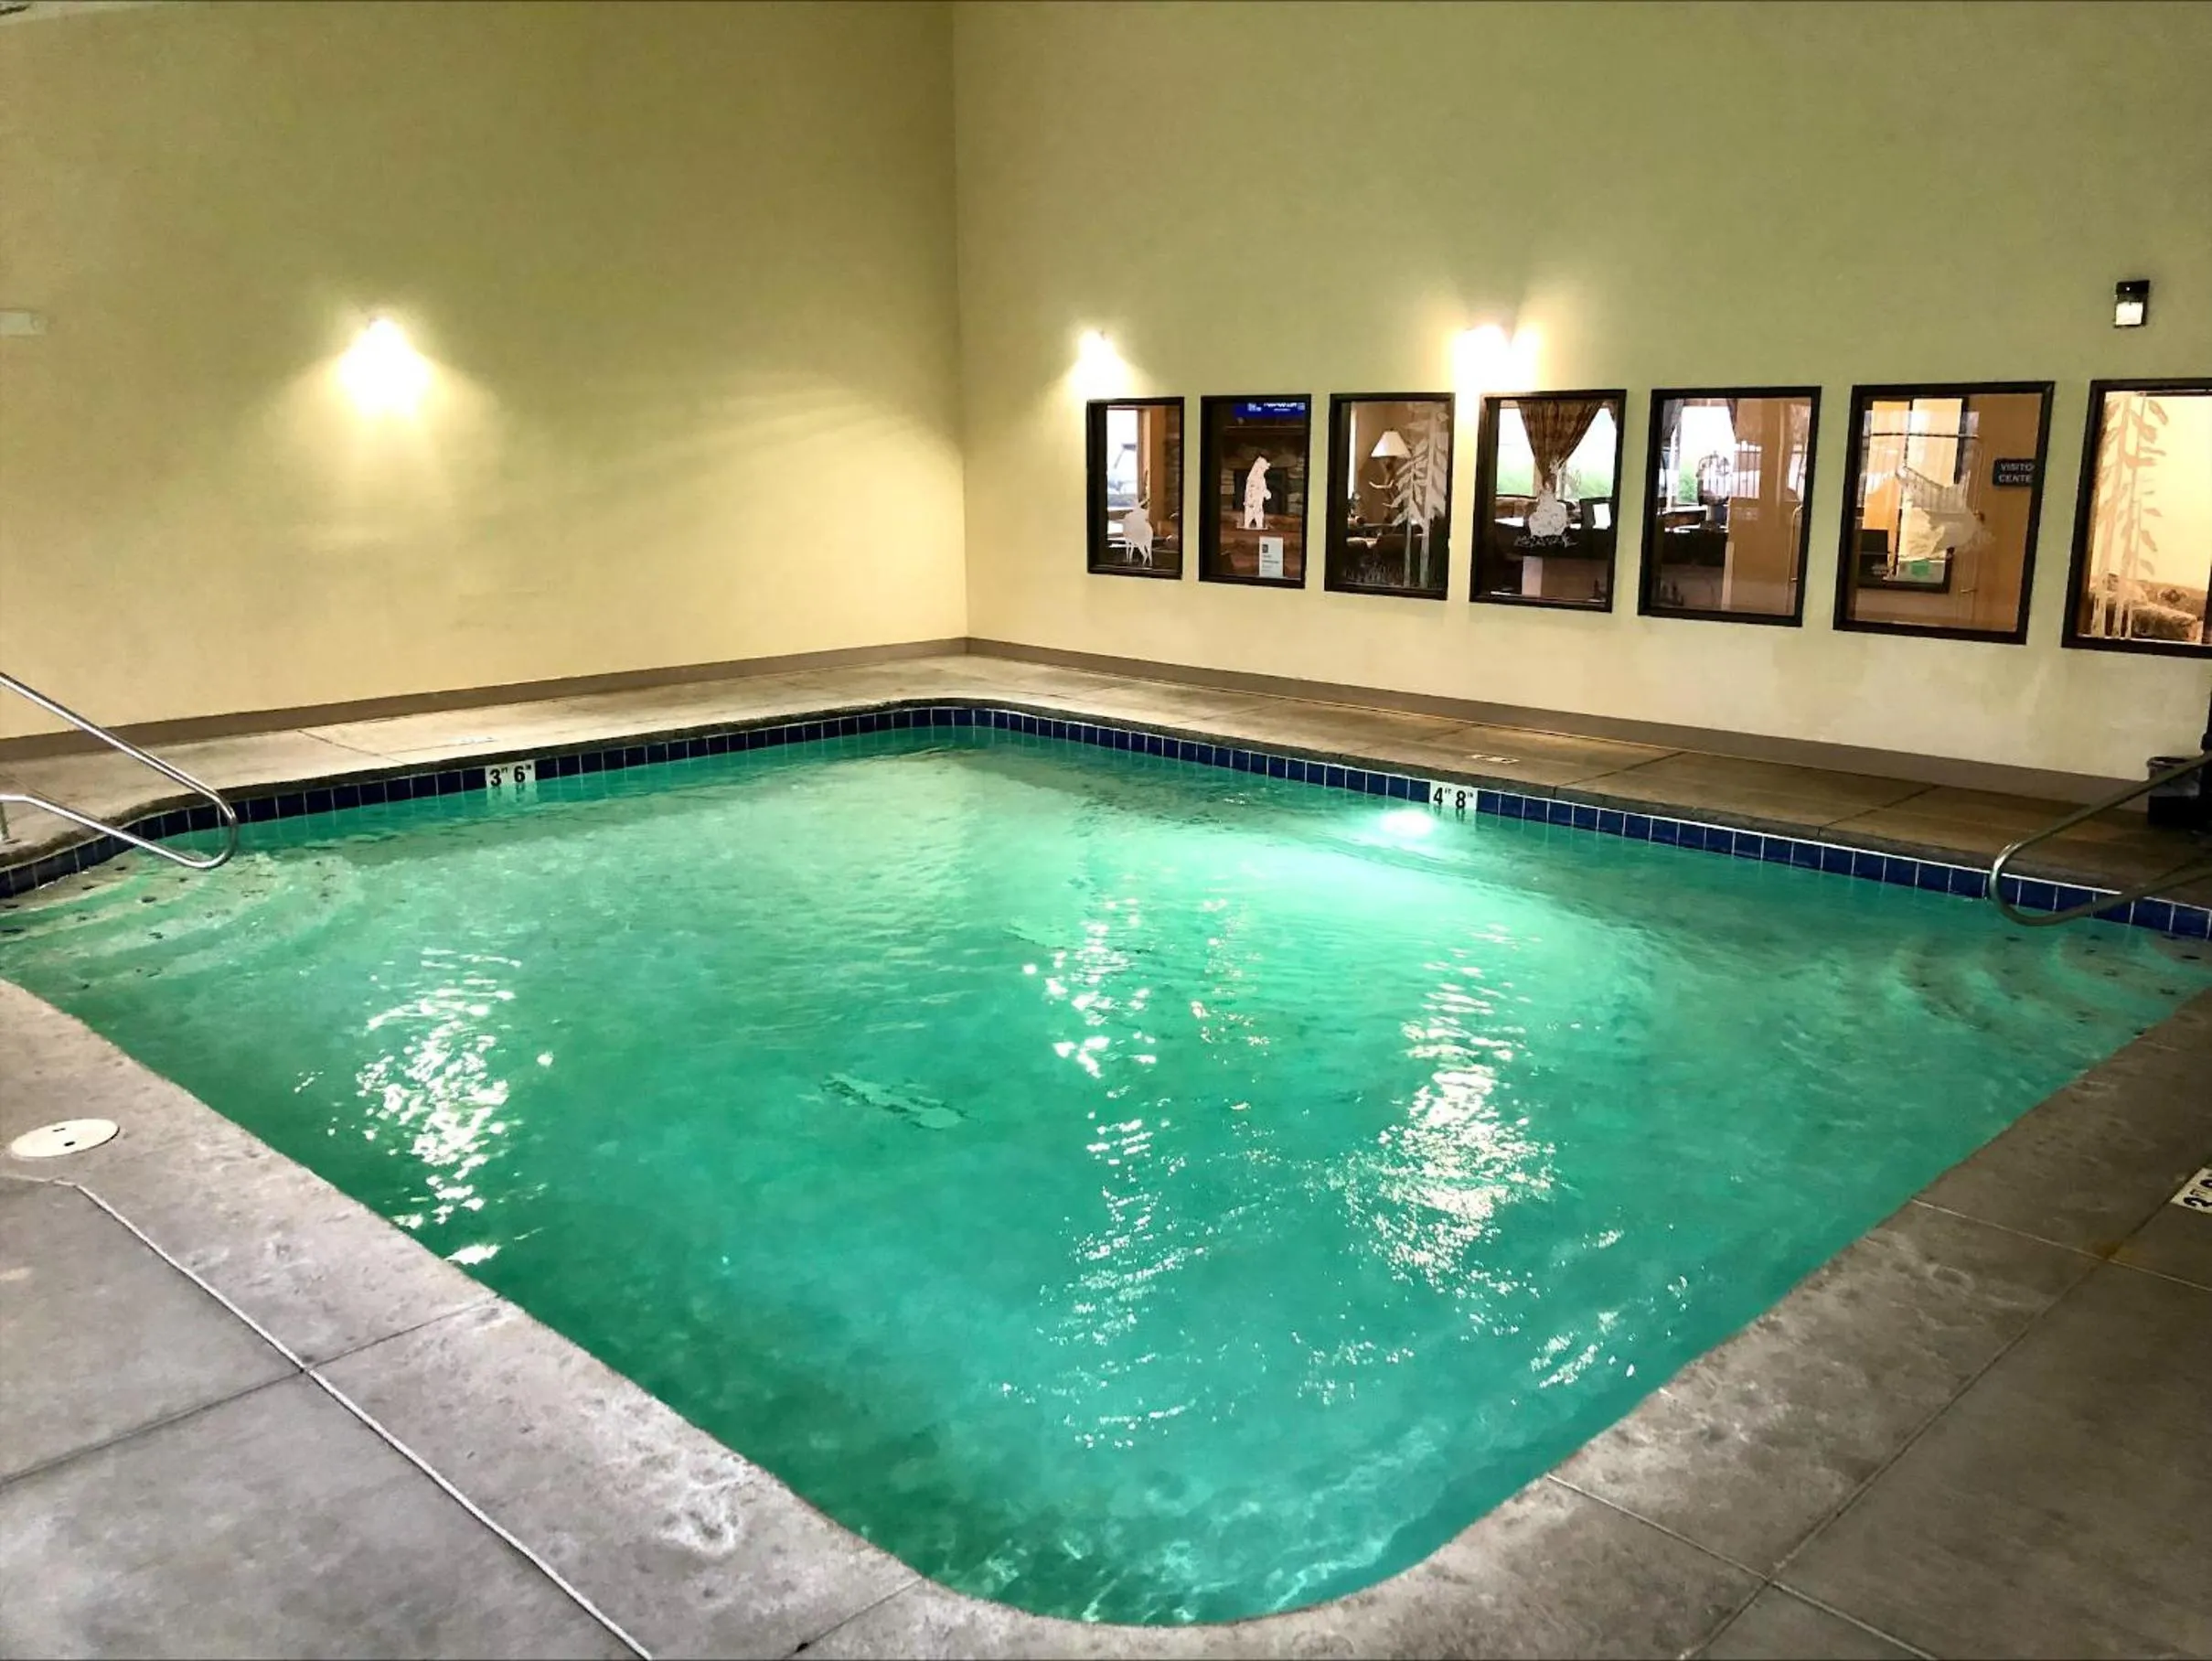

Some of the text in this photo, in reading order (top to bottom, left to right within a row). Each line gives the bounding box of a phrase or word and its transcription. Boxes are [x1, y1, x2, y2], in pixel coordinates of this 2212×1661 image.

[2000, 463, 2036, 472] VISITO
[1998, 474, 2034, 483] CENTE
[489, 768, 502, 787] 3
[514, 766, 526, 783] 6
[1433, 787, 1443, 806] 4
[1455, 789, 1467, 809] 8
